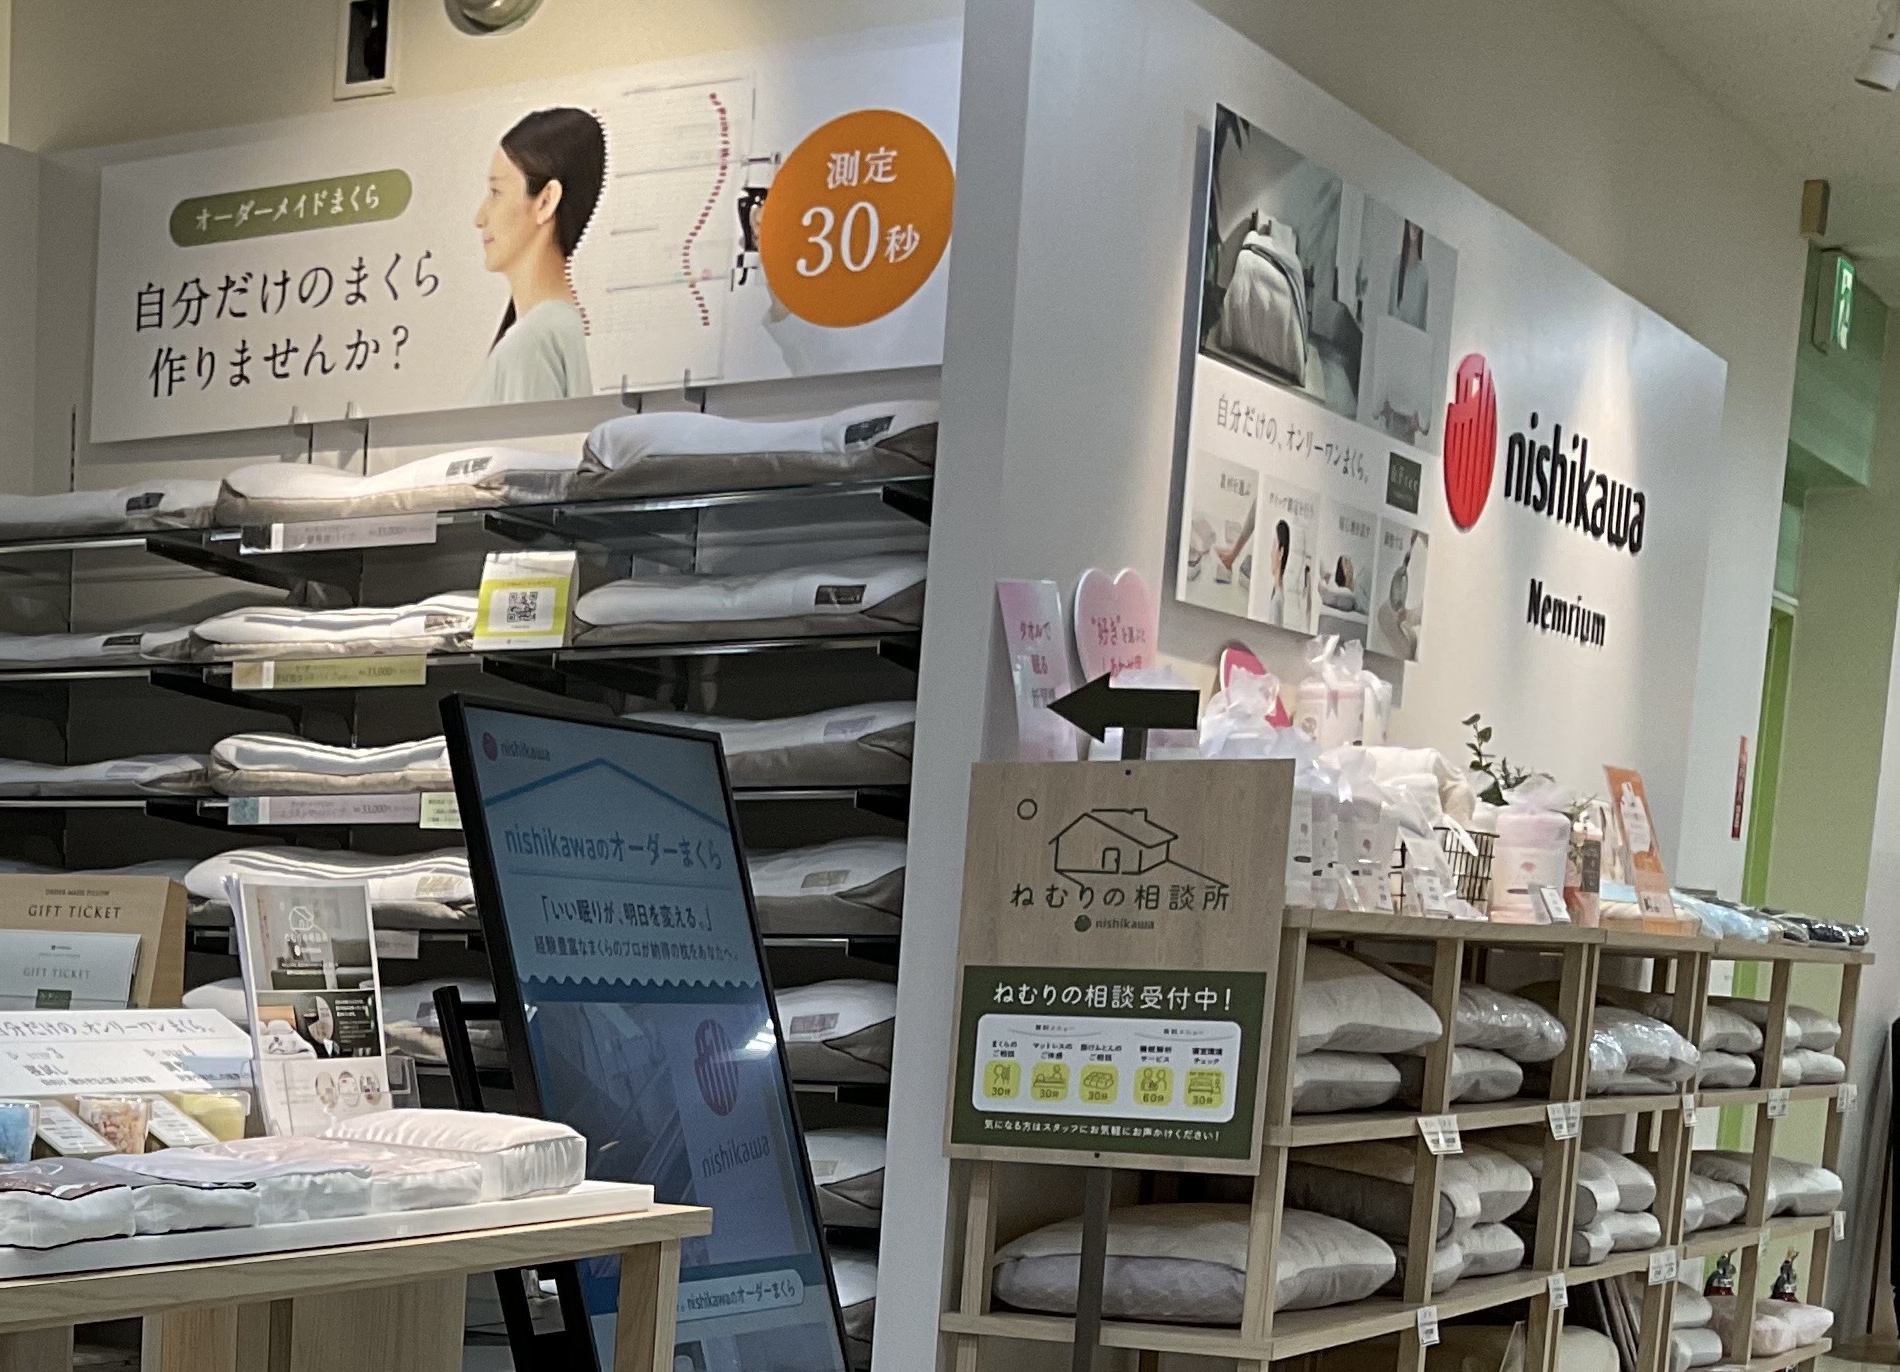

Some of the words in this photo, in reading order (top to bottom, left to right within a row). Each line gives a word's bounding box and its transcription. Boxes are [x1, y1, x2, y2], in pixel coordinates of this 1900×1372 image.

[826, 146, 898, 189] 測定
[195, 183, 381, 234] オーダーメイドまくら
[795, 199, 921, 279] 30秒
[134, 249, 441, 332] 自分だけのまくら
[147, 324, 410, 399] 作りませんか?
[1503, 411, 1647, 555] nishikawa
[1527, 577, 1607, 648] Nemrium
[504, 825, 723, 872] nishikawaのオーダーまくら
[28, 905, 62, 918] GIFT
[68, 906, 122, 919] TICKET
[1010, 881, 1231, 912] ねむりの相談所
[1095, 918, 1155, 931] nishikawa
[23, 967, 48, 979] GIFT
[52, 968, 91, 980] TICKET
[993, 981, 1232, 1013] ねむりの相談受付中!
[701, 1135, 771, 1179] nishikawa
